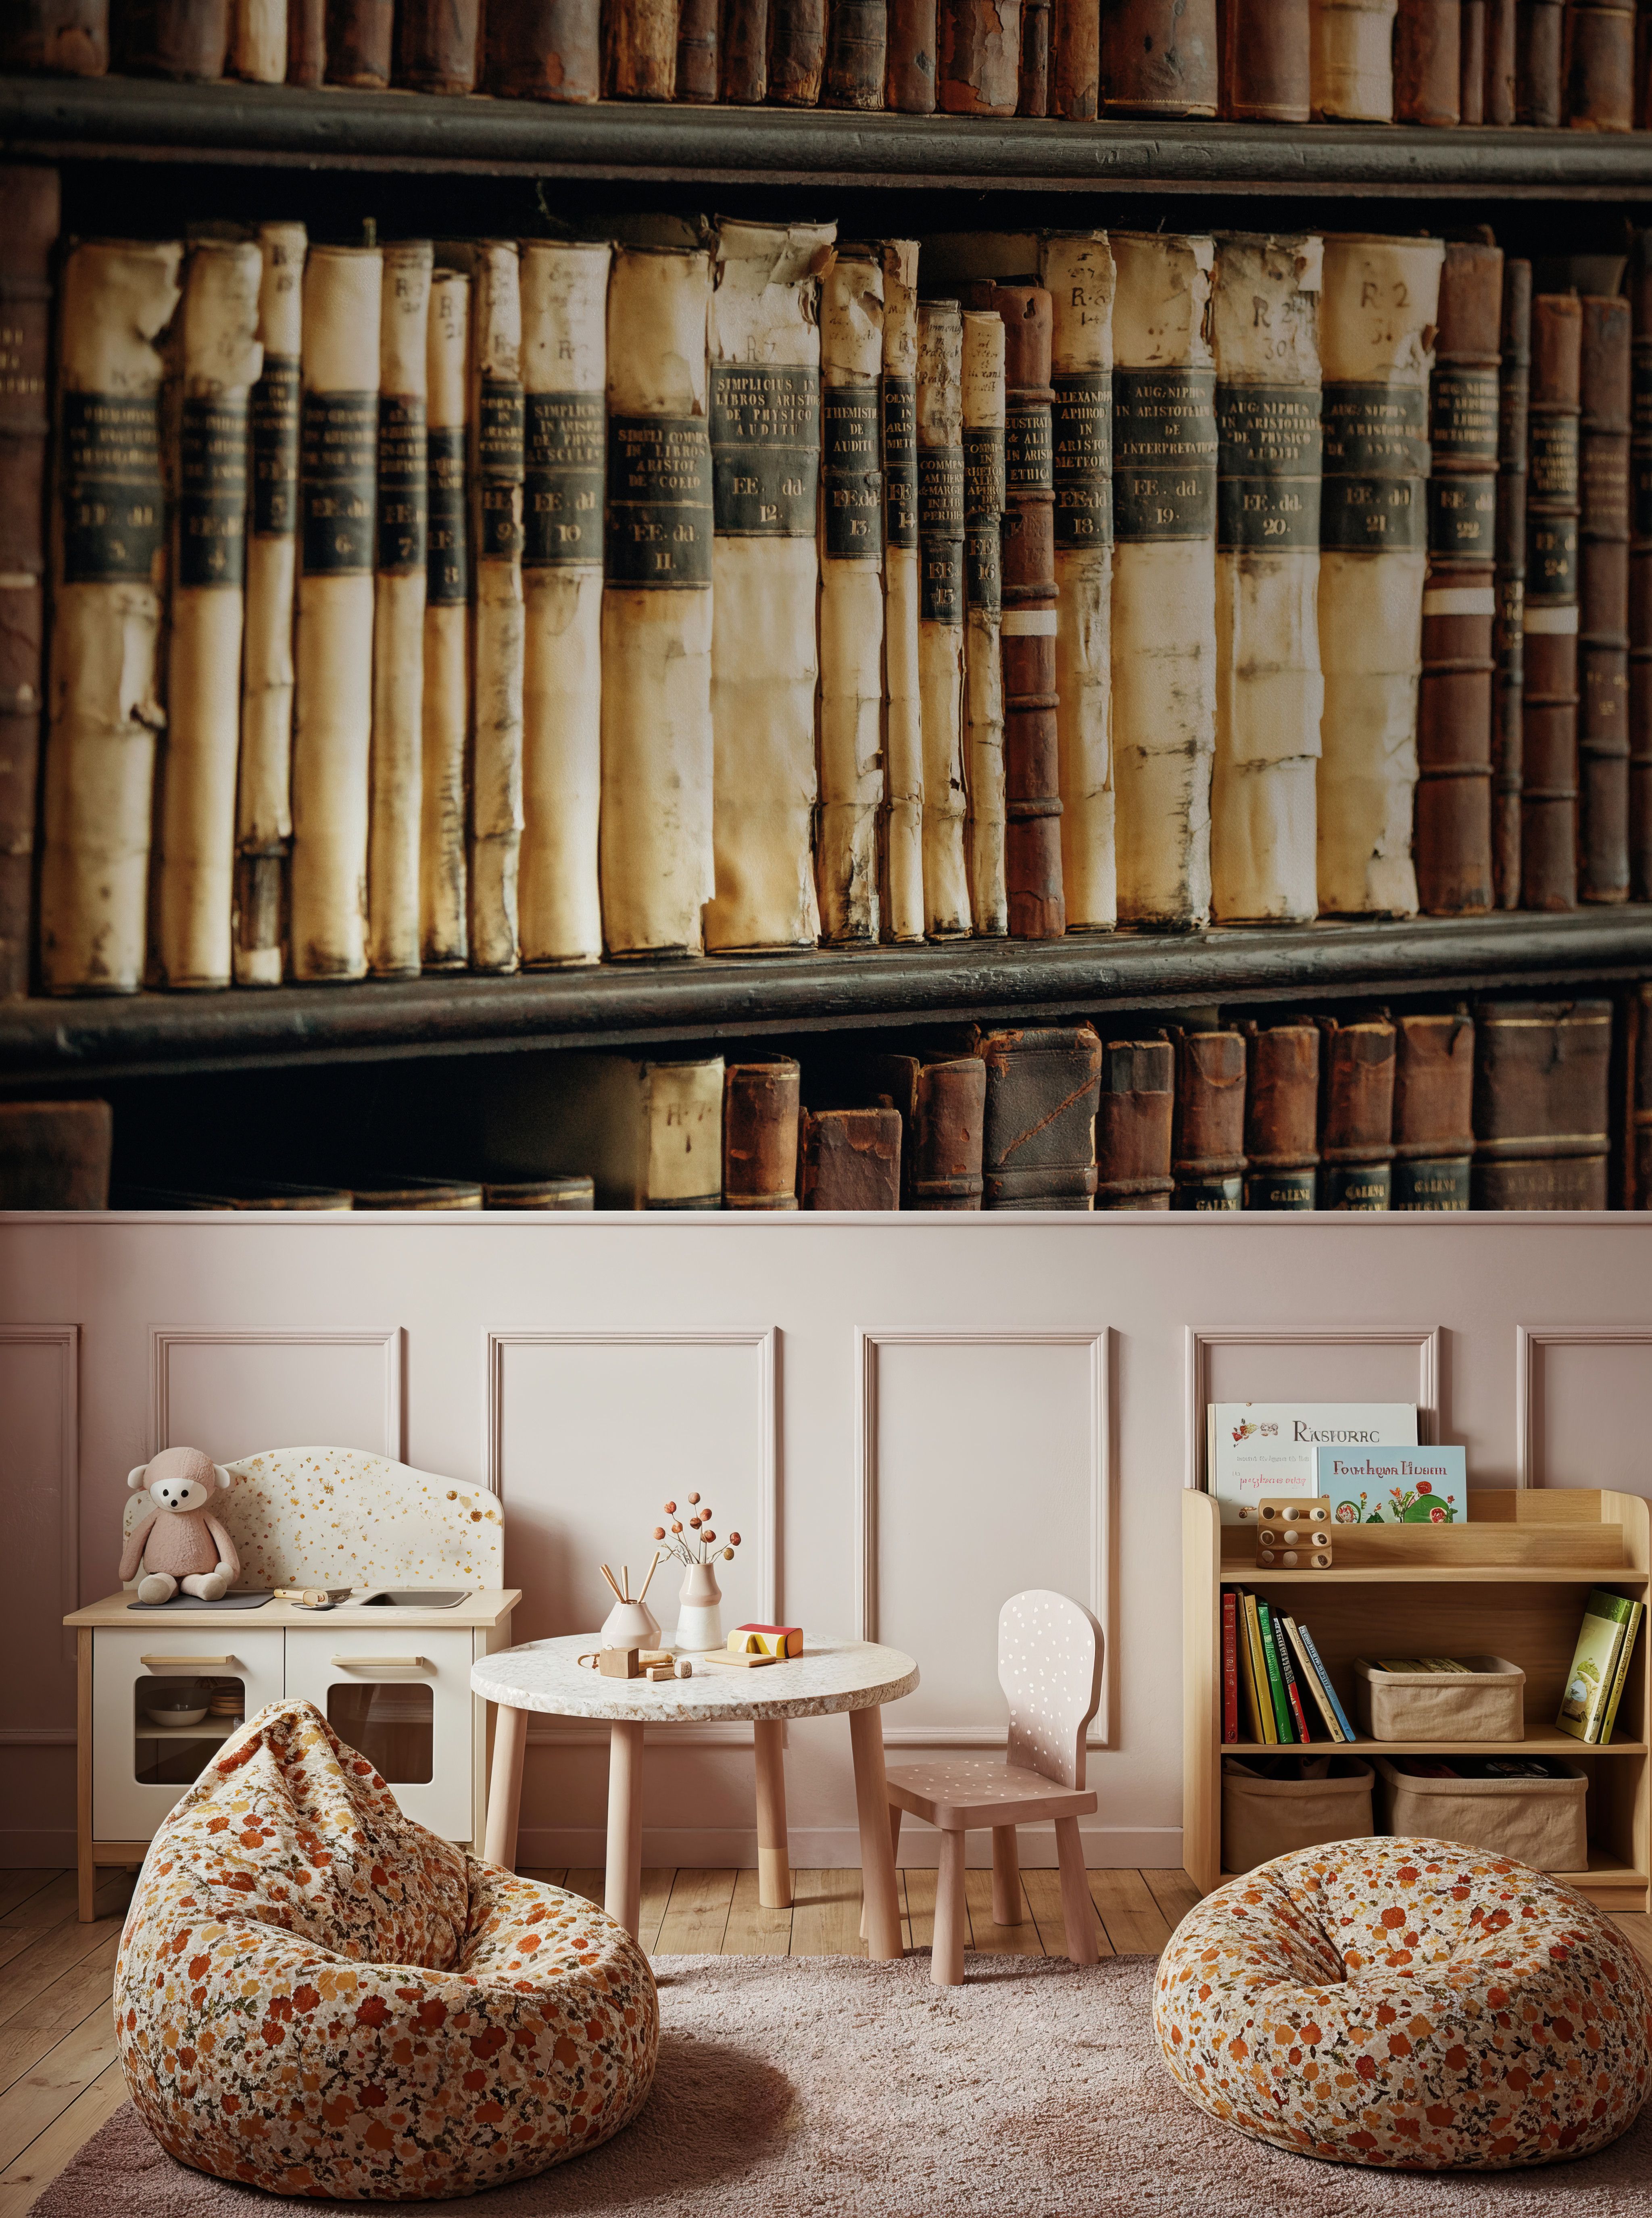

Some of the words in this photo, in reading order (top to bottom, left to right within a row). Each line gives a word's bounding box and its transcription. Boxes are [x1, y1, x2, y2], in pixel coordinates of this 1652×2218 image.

[717, 378, 793, 391] SIMPLICIUS
[803, 380, 815, 391] IN
[715, 393, 766, 406] LIBROS
[726, 409, 741, 421] DE
[753, 409, 812, 421] PHYSICO
[901, 409, 912, 419] IN
[1061, 408, 1106, 419] APHROD
[1116, 405, 1130, 417] IN
[736, 423, 798, 436] AUDITU
[850, 423, 864, 435] DE
[1079, 423, 1093, 435] IN
[1164, 424, 1181, 436] DE
[656, 444, 705, 458] LIBROS
[833, 440, 874, 452] AUDITU
[1006, 448, 1020, 461] IN
[920, 460, 964, 470] COMMEN
[928, 498, 941, 509] IN
[943, 498, 961, 507] LIB
[558, 524, 582, 542] 10
[978, 563, 995, 580] 16
